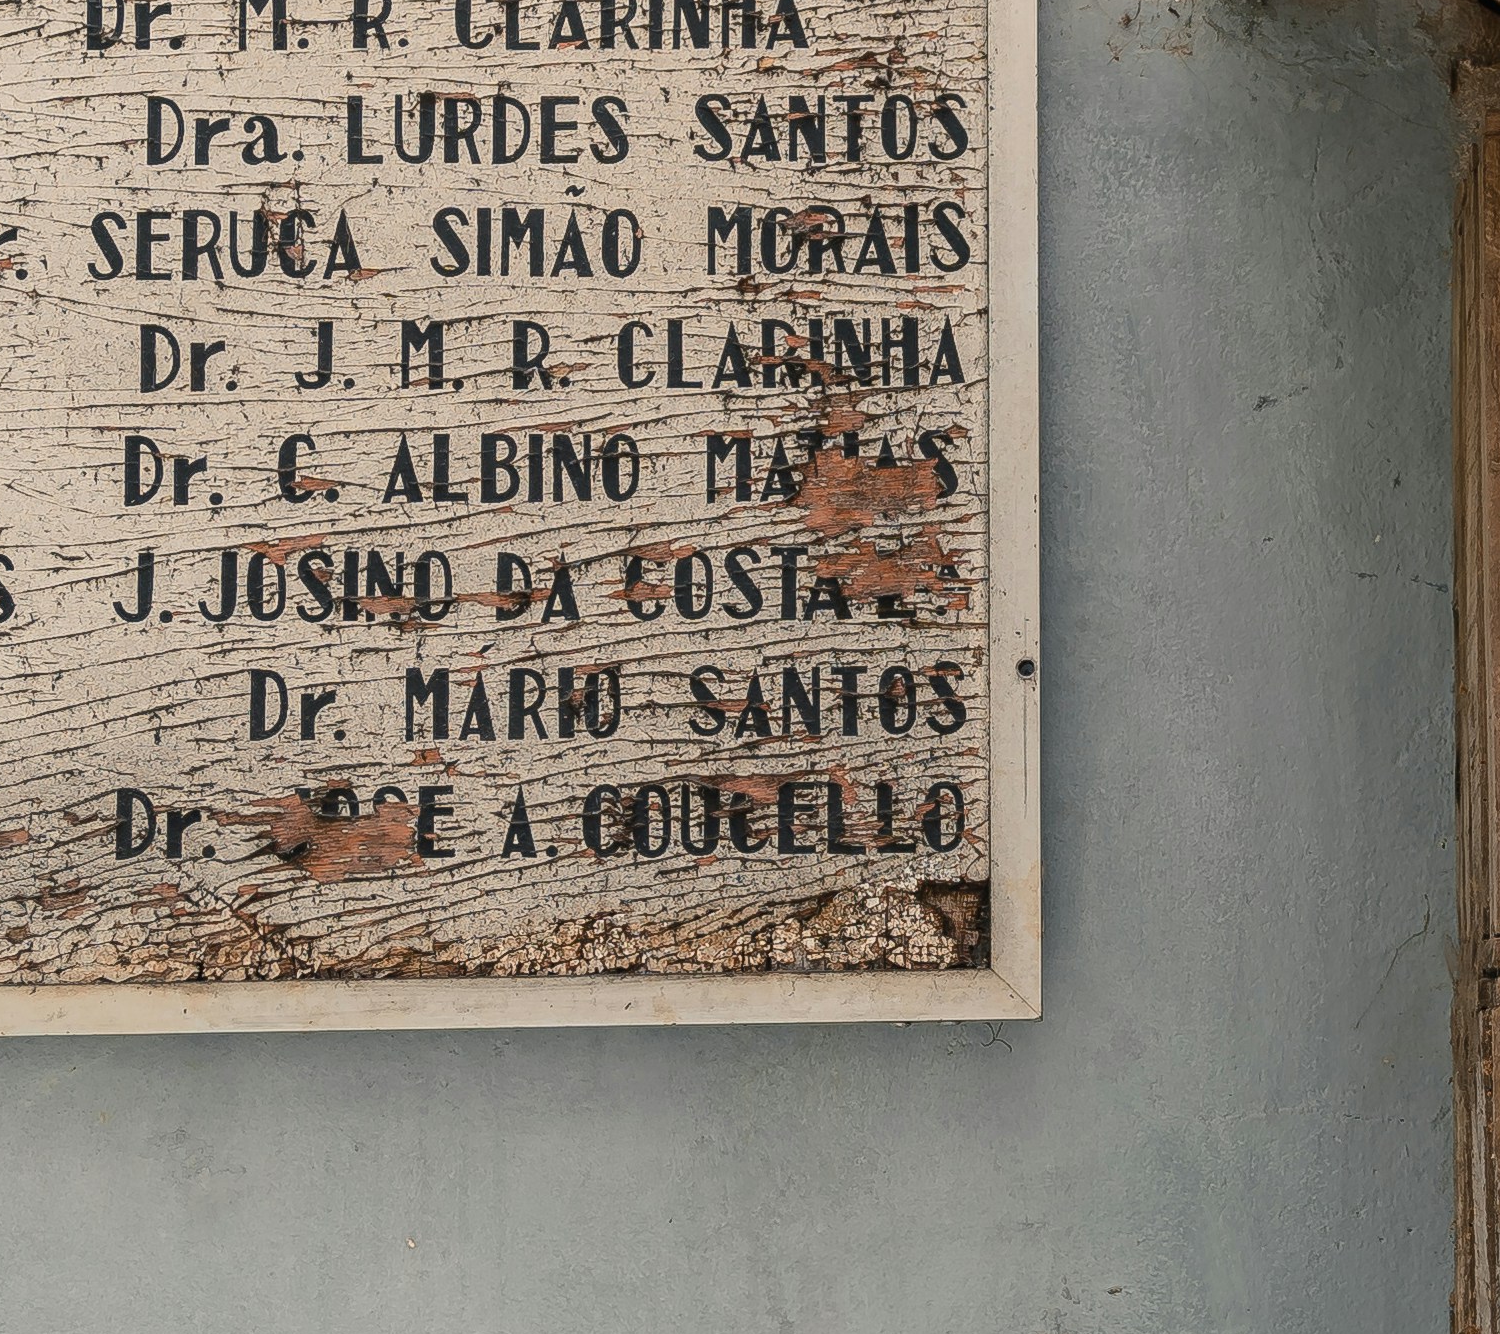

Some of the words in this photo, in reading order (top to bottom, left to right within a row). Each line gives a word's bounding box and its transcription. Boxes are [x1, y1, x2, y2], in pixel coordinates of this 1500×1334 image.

[147, 97, 304, 166] Dra.
[347, 96, 629, 165] LURDES
[694, 94, 970, 165] SANTOS
[87, 208, 363, 281] SERUCA
[431, 185, 642, 279] SIMÃO
[707, 201, 971, 278] MORAIS
[140, 323, 238, 394] Dr.
[296, 320, 355, 391] J.
[400, 319, 465, 391] M.
[513, 319, 572, 390] R.
[617, 315, 965, 389] CLARINHA
[124, 435, 224, 507] Dr.
[277, 434, 339, 505] C.
[383, 432, 641, 505] ALBINO
[112, 551, 174, 622] J.
[198, 550, 454, 622] JOSINO
[497, 549, 580, 622] DA
[626, 547, 853, 621] COSTA
[249, 669, 347, 741] Dr.
[405, 642, 621, 741] MÁRIO
[689, 661, 967, 738] SANTOS
[115, 786, 217, 861] Dr.
[500, 783, 560, 859] A.
[581, 780, 966, 857] COUCELLO
